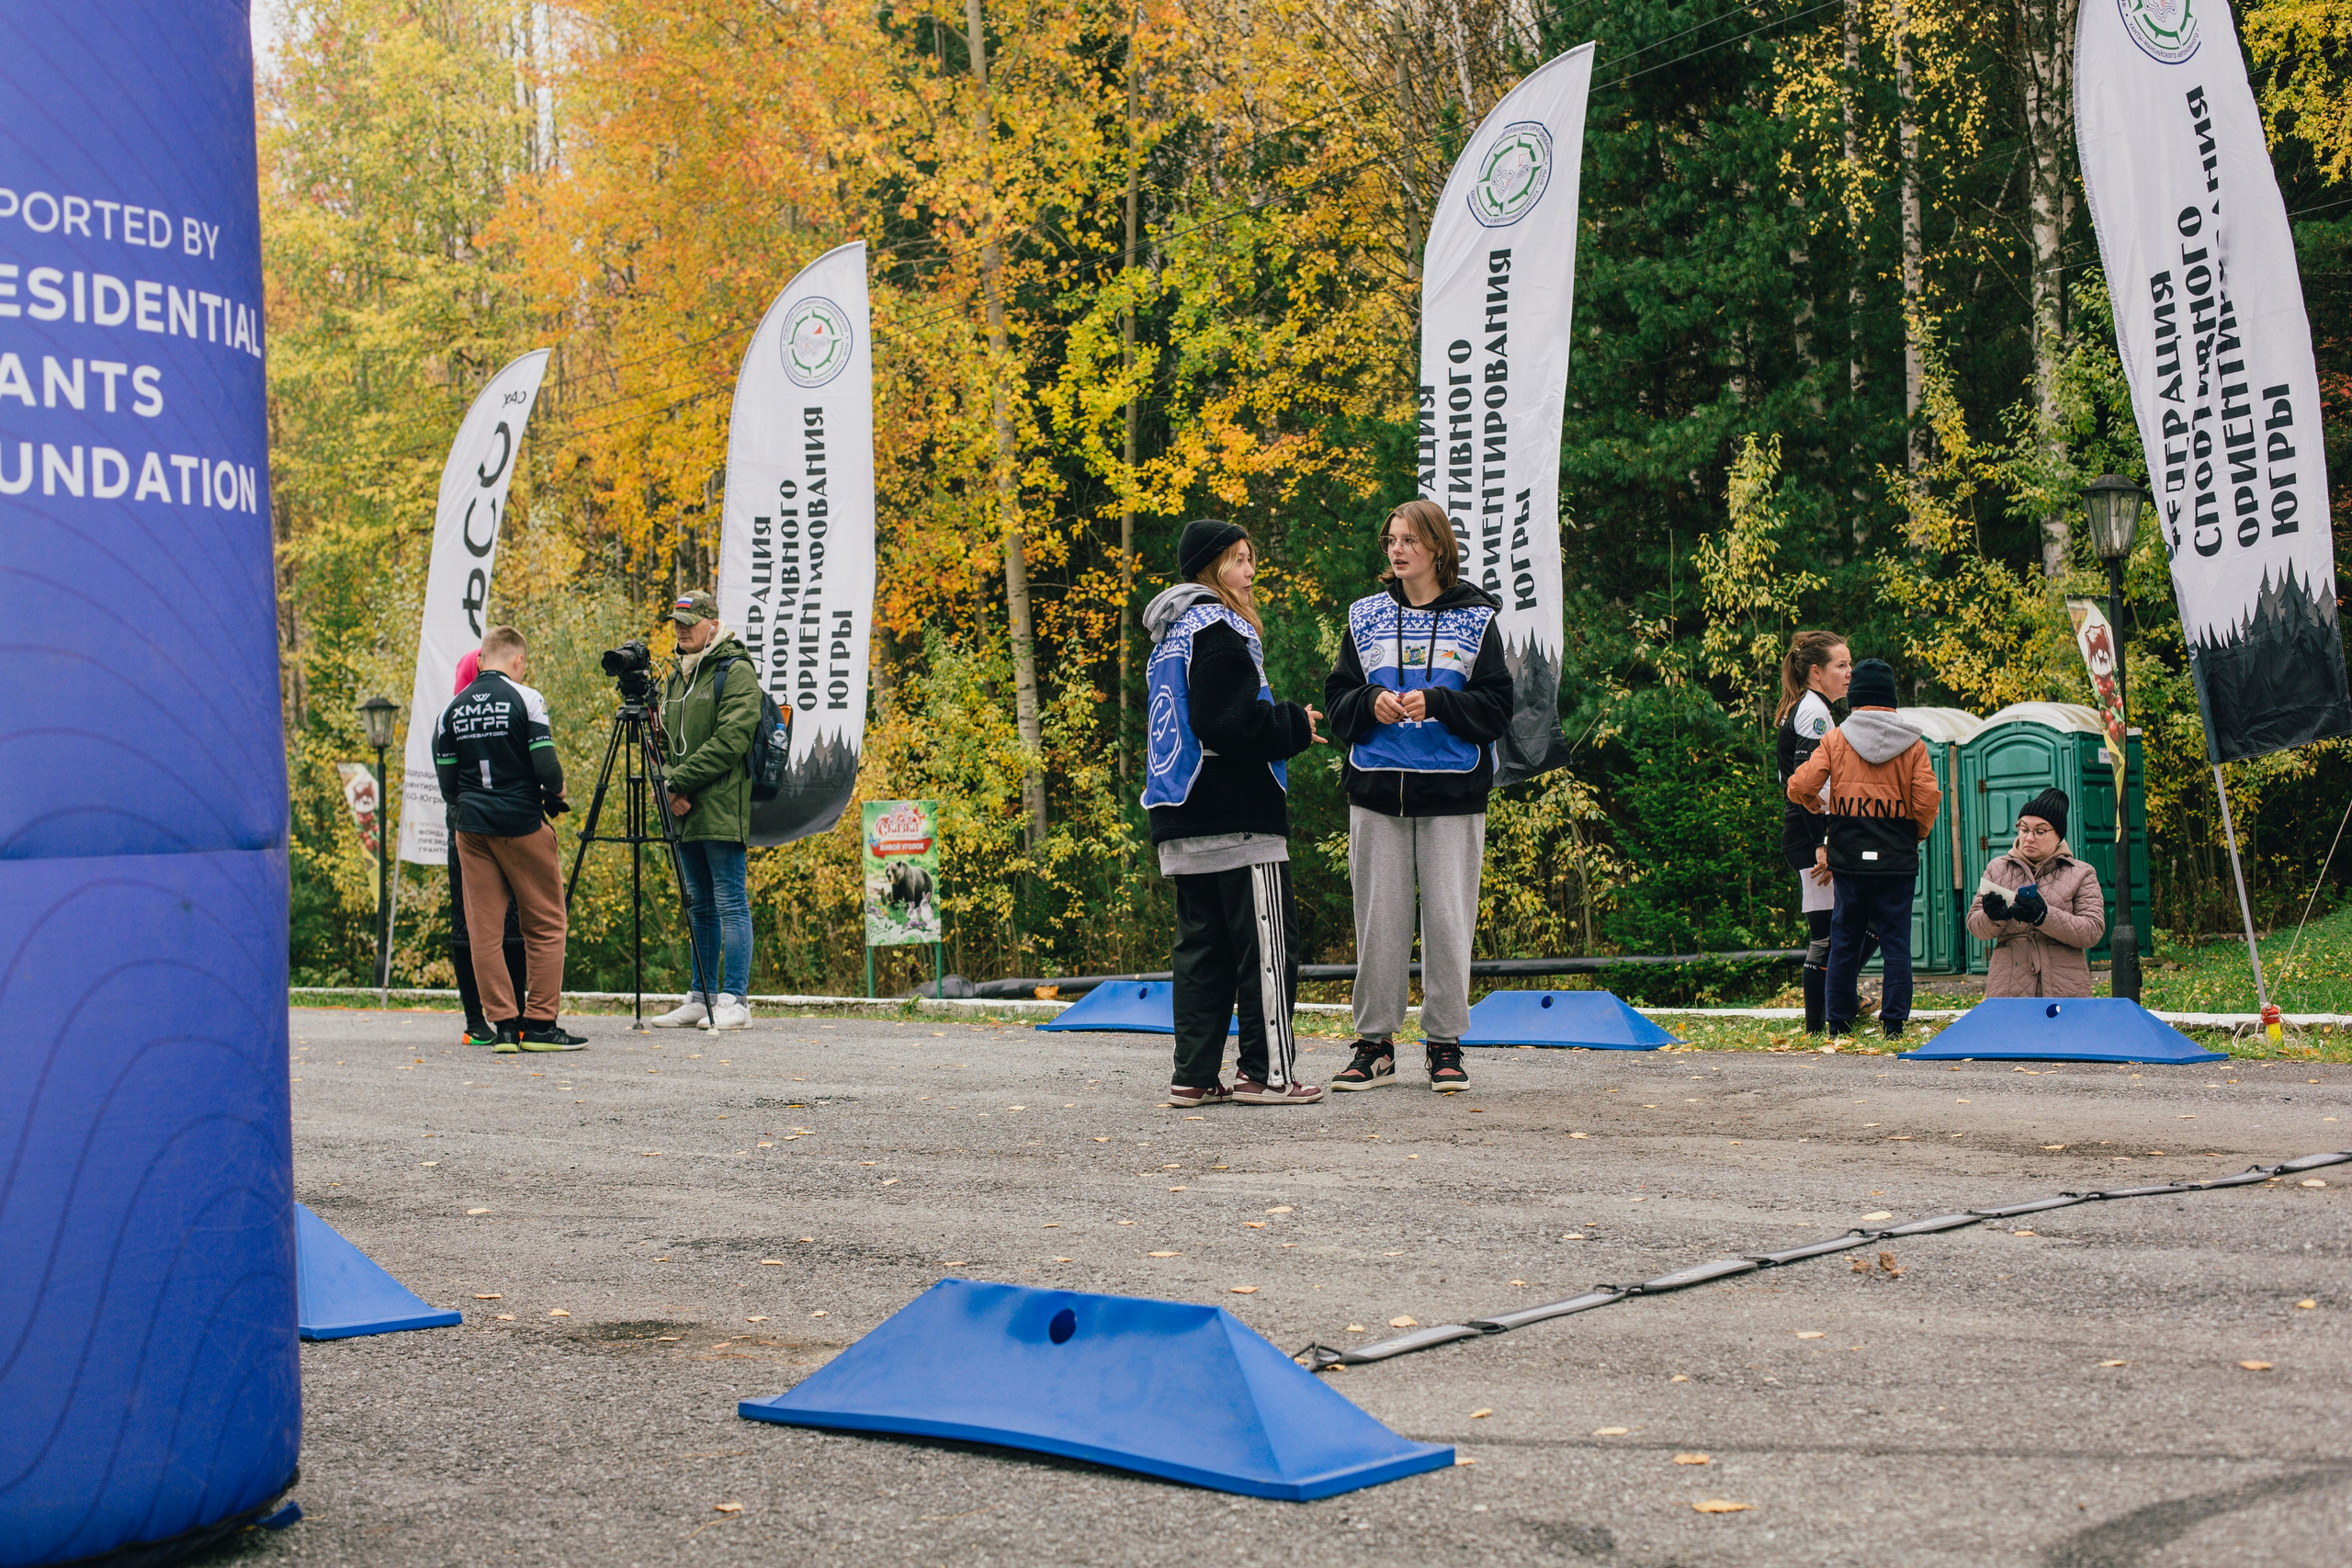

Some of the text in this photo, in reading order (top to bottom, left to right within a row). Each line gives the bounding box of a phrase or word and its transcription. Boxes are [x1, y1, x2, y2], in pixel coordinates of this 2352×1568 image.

[183, 217, 220, 261] BY
[0, 352, 164, 417] ANTS
[2262, 383, 2300, 538] ЮГРЫ
[797, 407, 829, 711] ОРИЕНТИРОВАНИЯ
[1510, 488, 1537, 612] ЮГРЫ
[452, 701, 511, 719] ХМАО
[828, 610, 853, 710] ЮГРЫ
